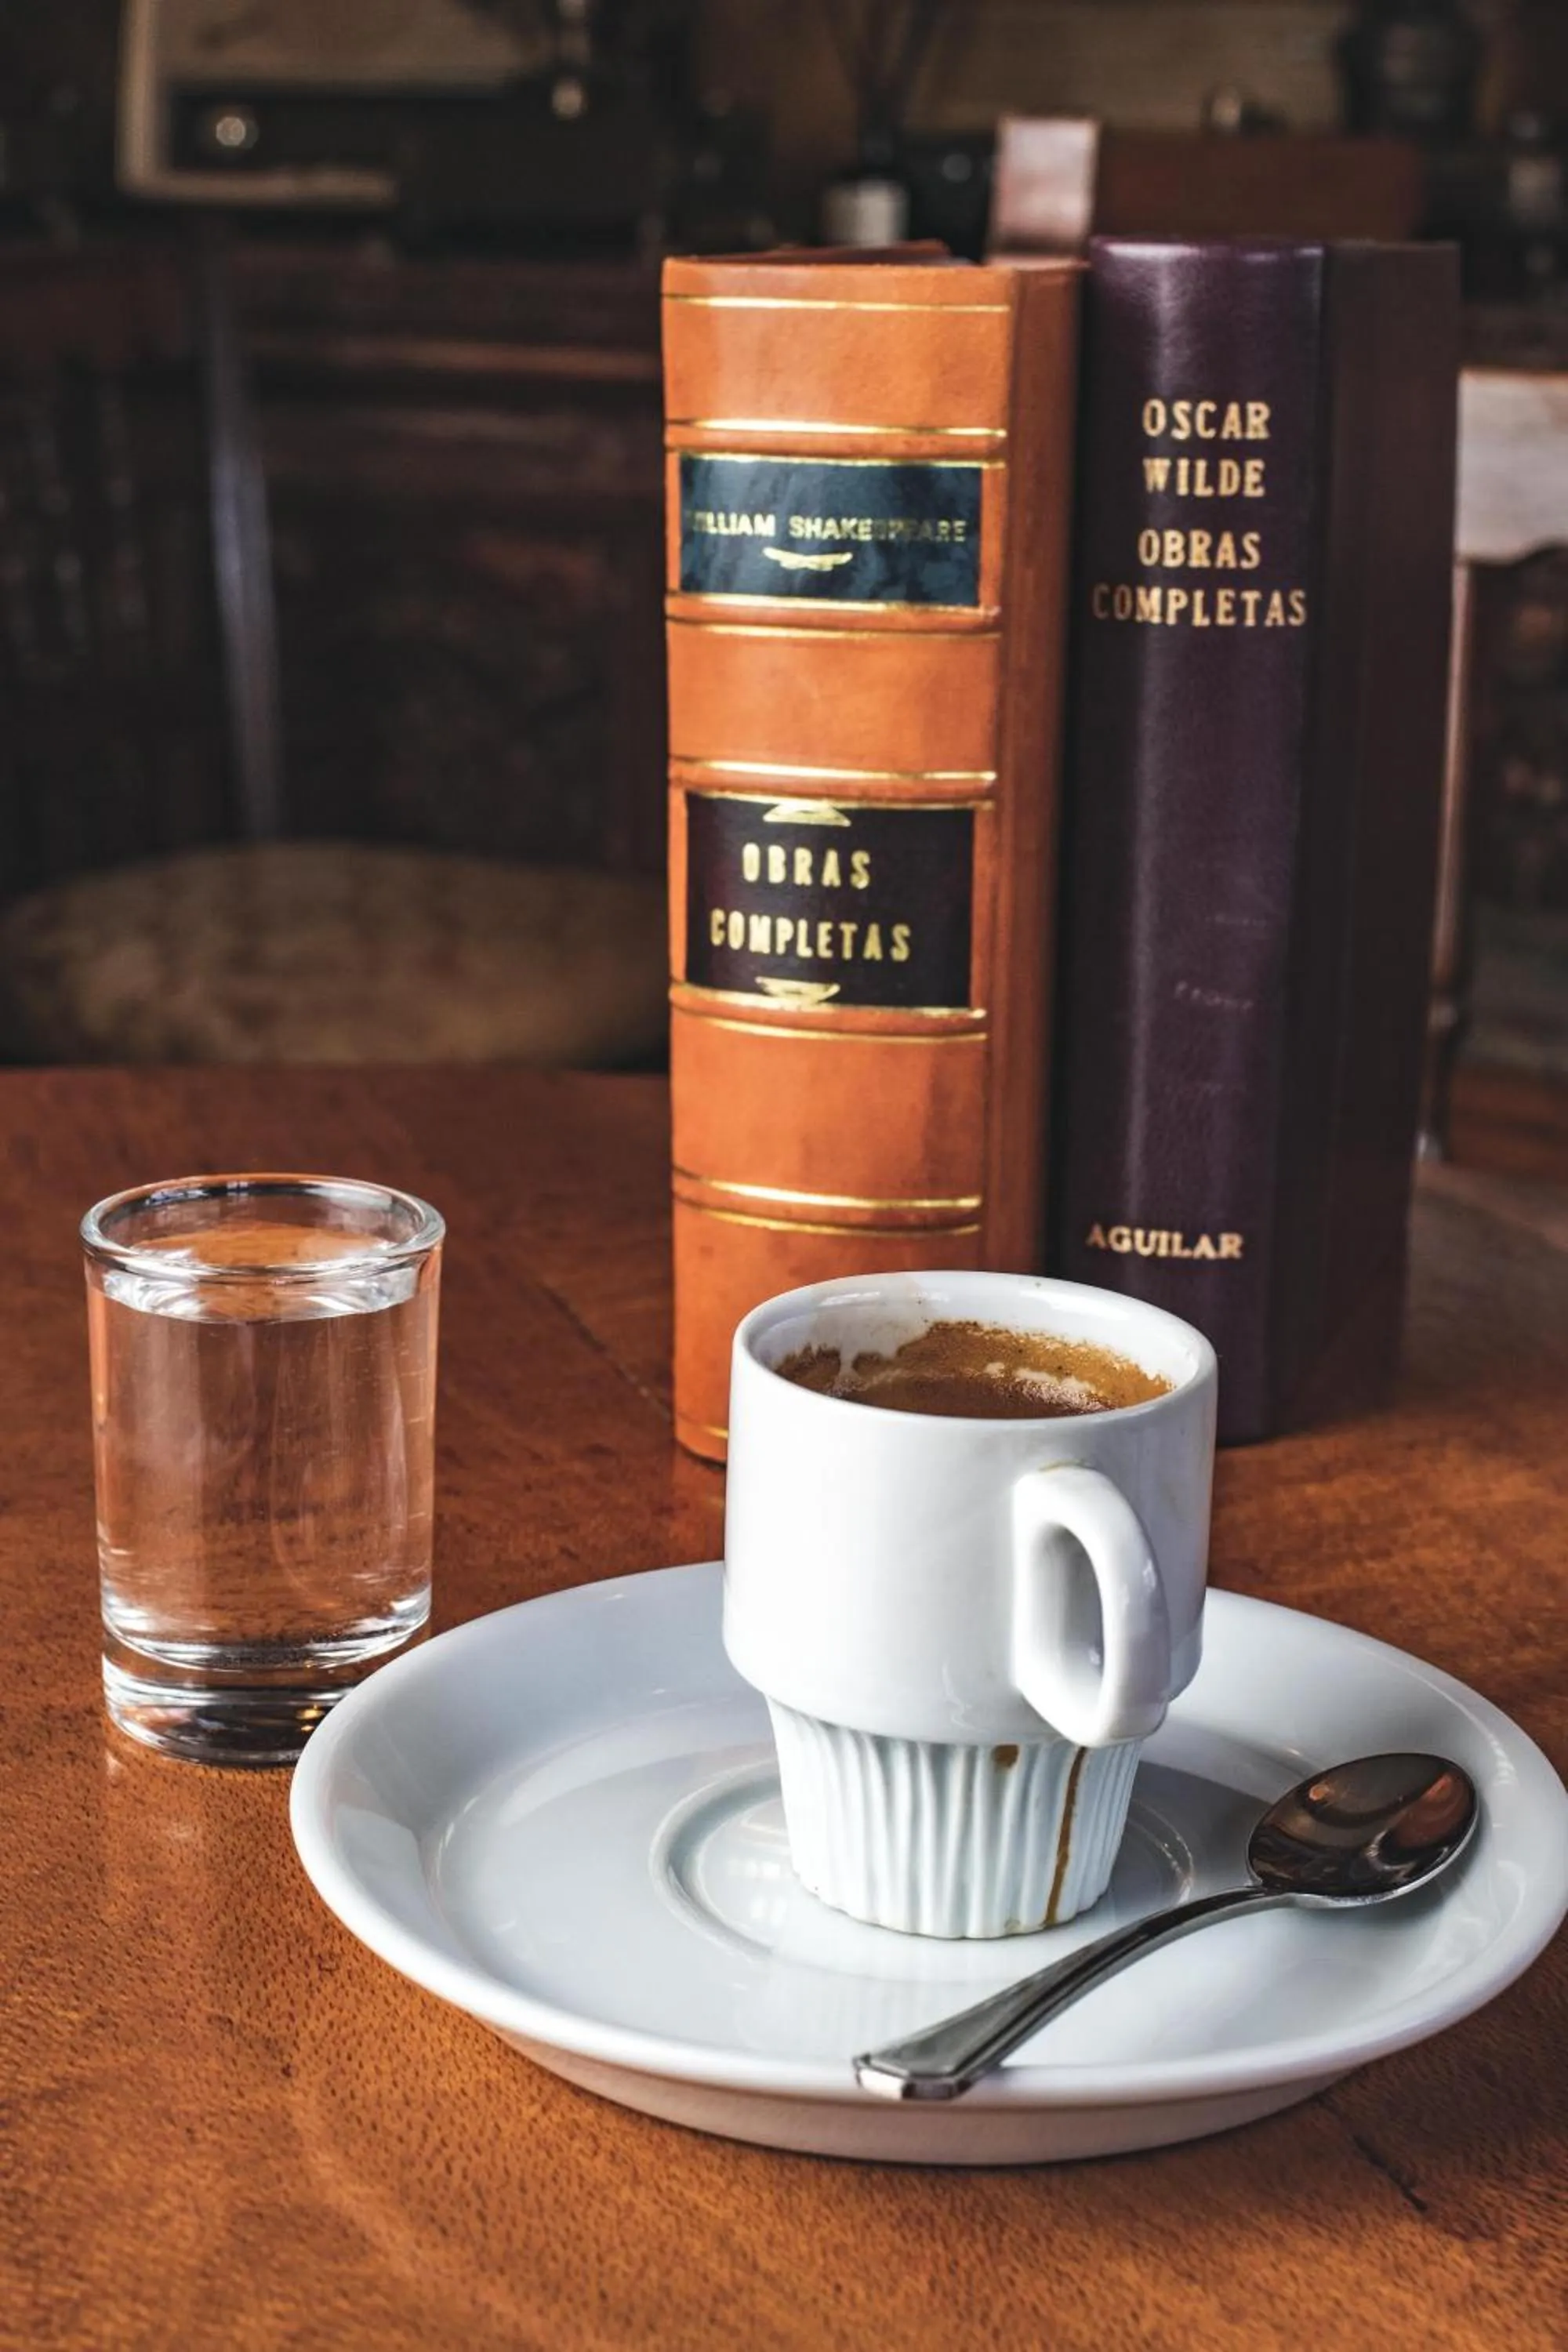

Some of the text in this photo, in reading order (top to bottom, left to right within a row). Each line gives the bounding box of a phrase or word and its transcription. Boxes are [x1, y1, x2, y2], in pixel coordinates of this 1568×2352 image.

[1142, 398, 1271, 440] OSCAR
[1142, 457, 1265, 497] WILDE
[688, 511, 967, 543] ILLIAM SHAKEPARE
[1138, 528, 1261, 570] OBRAS
[1092, 583, 1308, 627] COMPLETAS
[742, 842, 871, 889] OBRAS
[710, 908, 911, 962] COMPLETAS
[1087, 1224, 1243, 1260] AGUILAR
